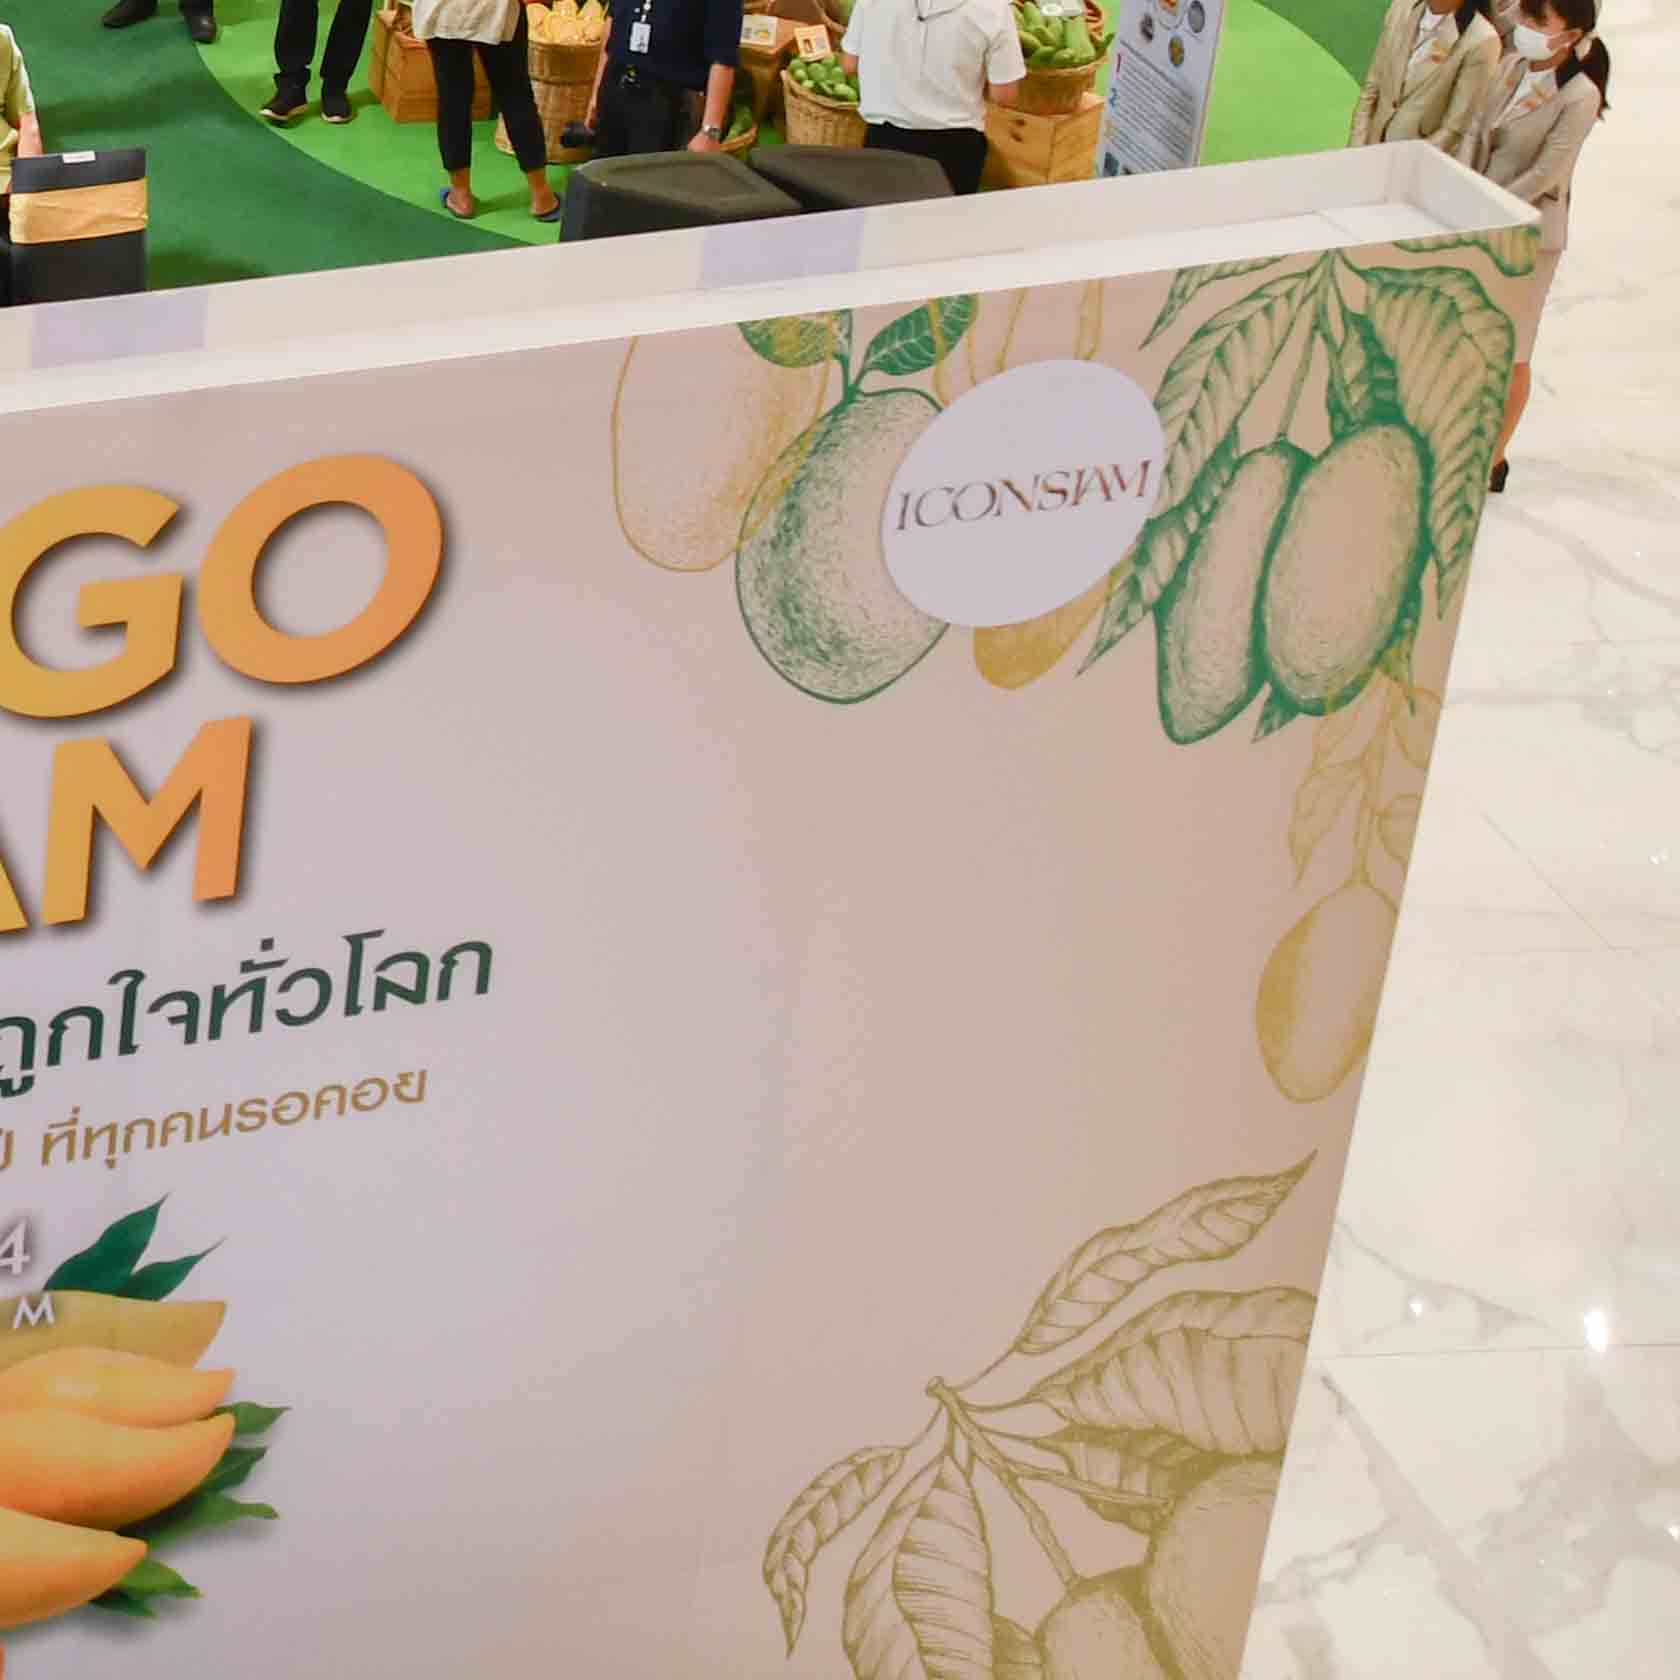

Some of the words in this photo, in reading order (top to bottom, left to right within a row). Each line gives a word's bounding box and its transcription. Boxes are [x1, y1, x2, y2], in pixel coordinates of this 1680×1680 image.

[896, 458, 1152, 531] ICONSIAM
[39, 1064, 428, 1168] ที่ทุกคนรอคอย
[13, 1296, 58, 1330] M
